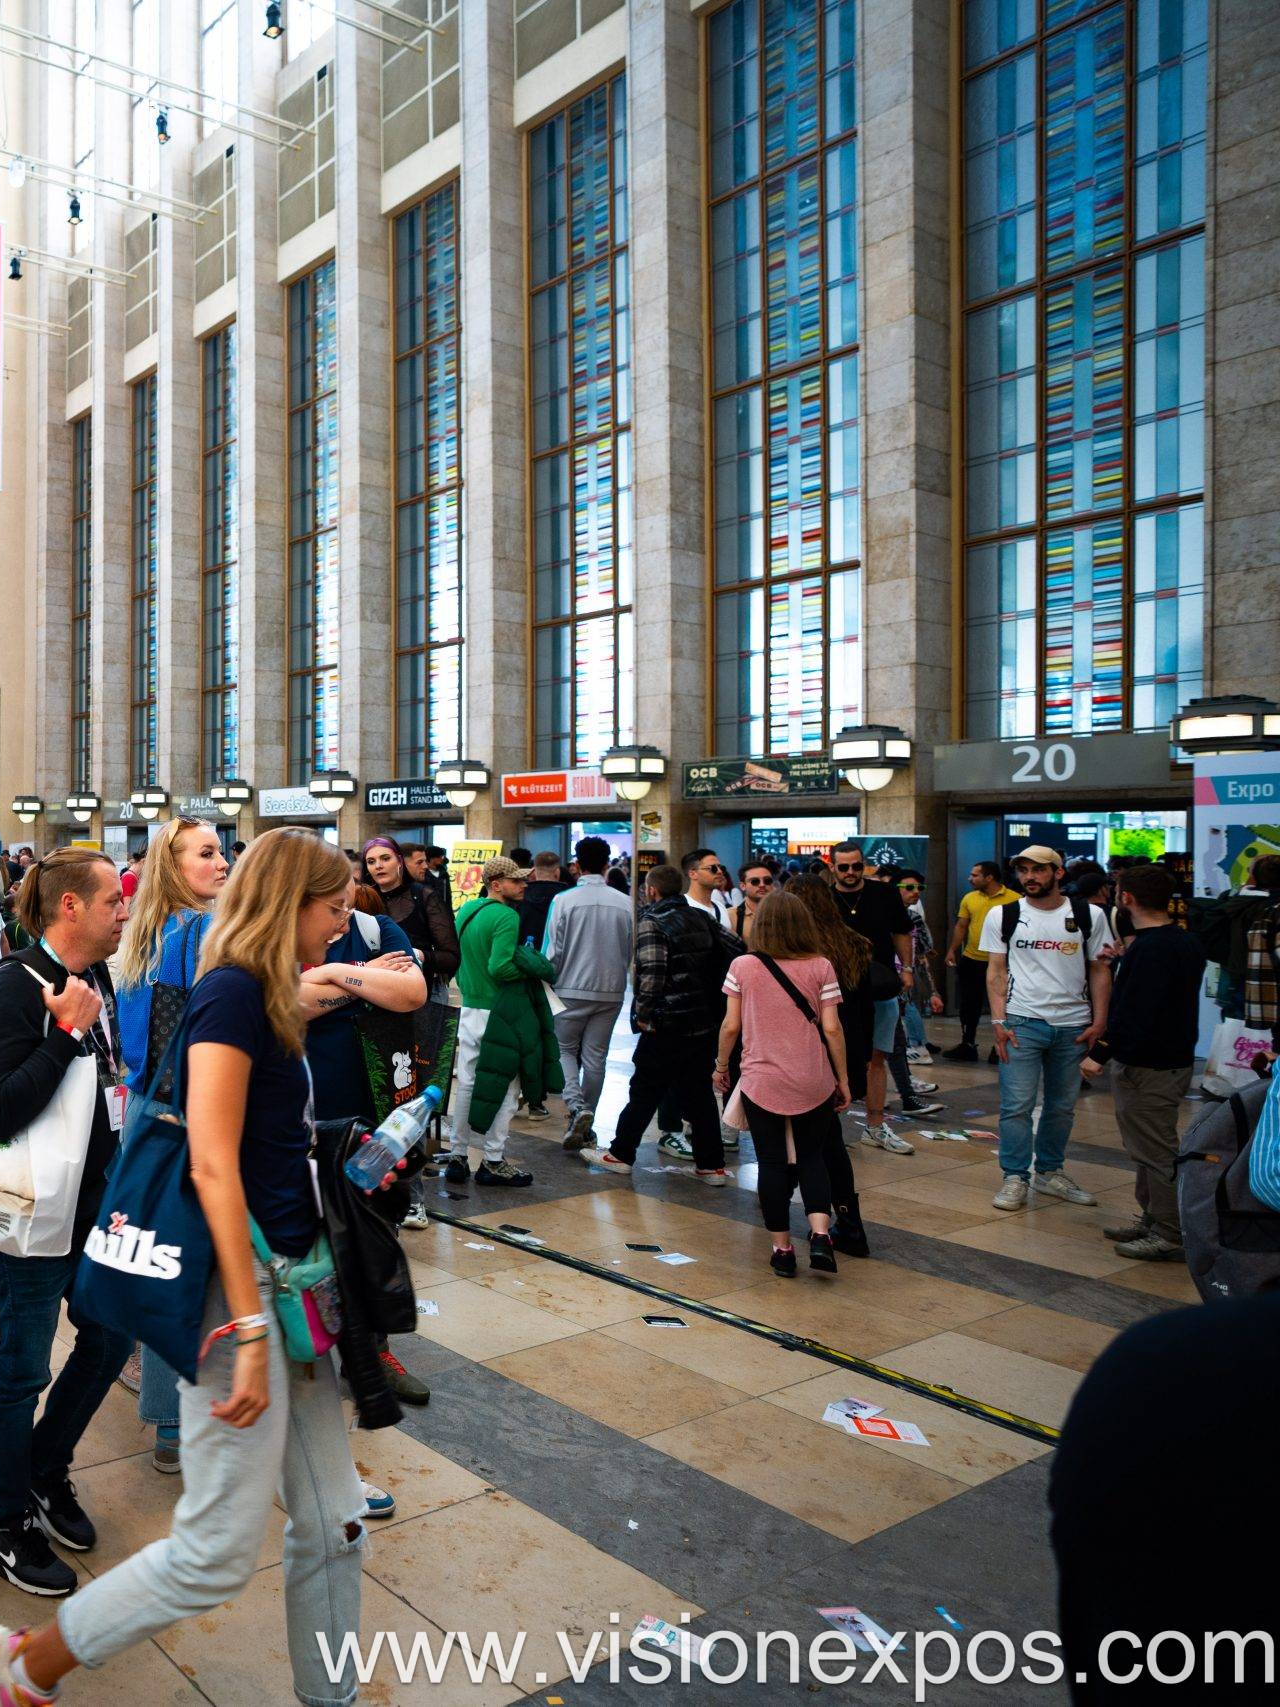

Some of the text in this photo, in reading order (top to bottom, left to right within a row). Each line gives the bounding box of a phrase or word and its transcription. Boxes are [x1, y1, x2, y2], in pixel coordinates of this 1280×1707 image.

[1012, 743, 1076, 783] 20
[690, 767, 717, 779] OCB
[410, 786, 431, 795] HALLE
[520, 783, 563, 794] BLÜTEZEIT
[1227, 781, 1274, 801] Expo
[369, 787, 407, 806] GIZEH
[410, 796, 433, 804] STAND
[120, 802, 133, 819] 20
[265, 795, 317, 813] Seeds24
[1016, 939, 1078, 950] CHECK24
